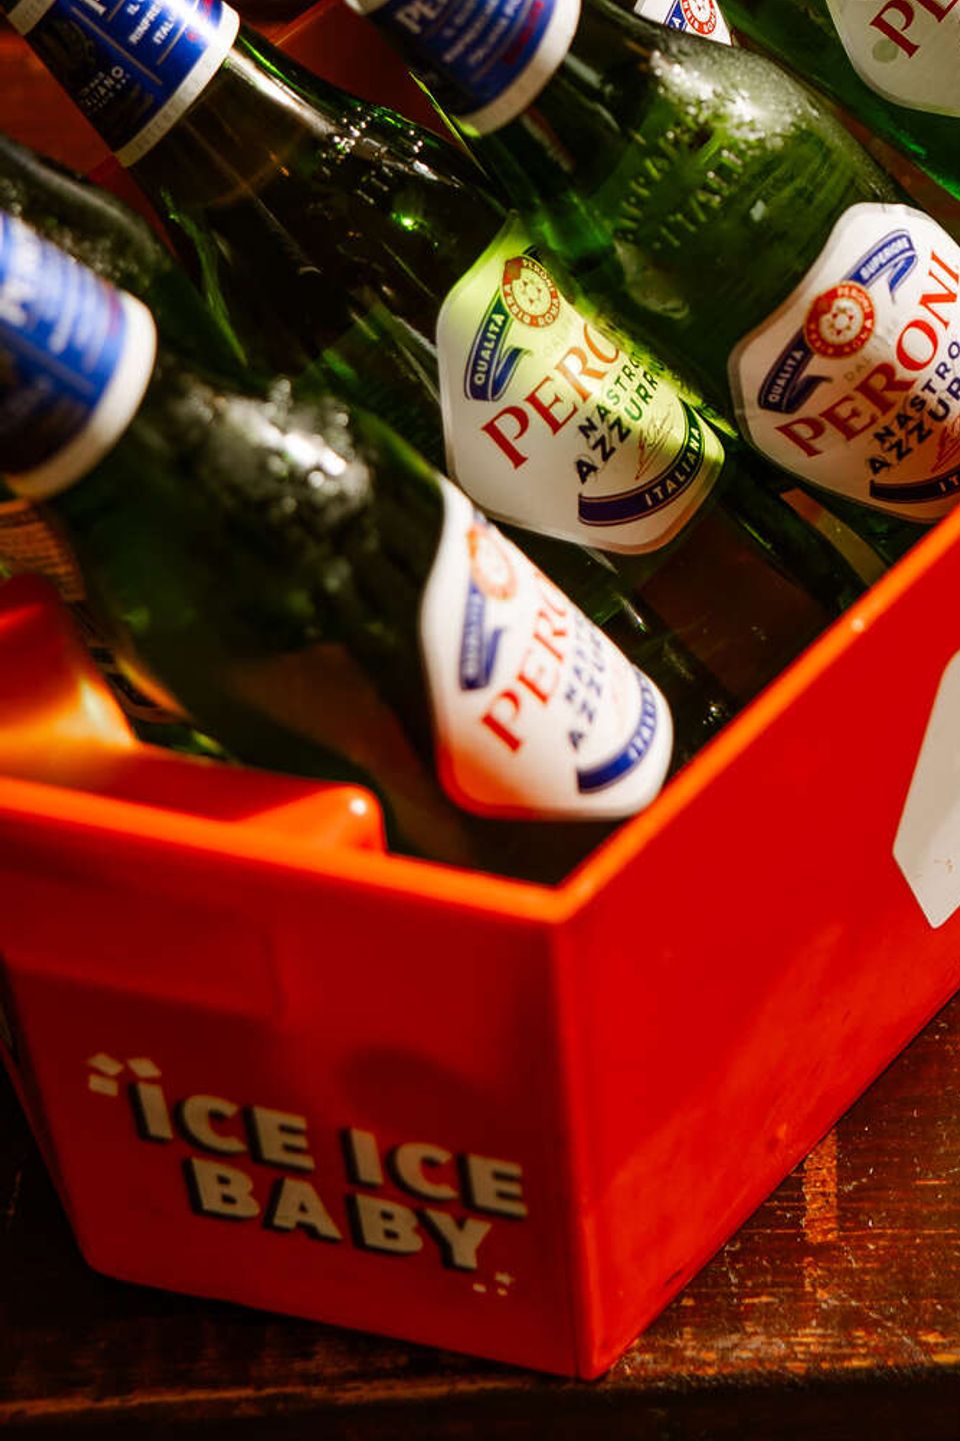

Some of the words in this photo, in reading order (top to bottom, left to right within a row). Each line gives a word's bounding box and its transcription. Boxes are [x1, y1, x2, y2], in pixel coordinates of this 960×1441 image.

[481, 322, 620, 470] PERO
[775, 250, 960, 458] PERONI
[873, 341, 960, 444] NASTRO
[644, 426, 702, 507] ITALIANA
[182, 1157, 492, 1270] BABY
[340, 1127, 527, 1218] ICE
